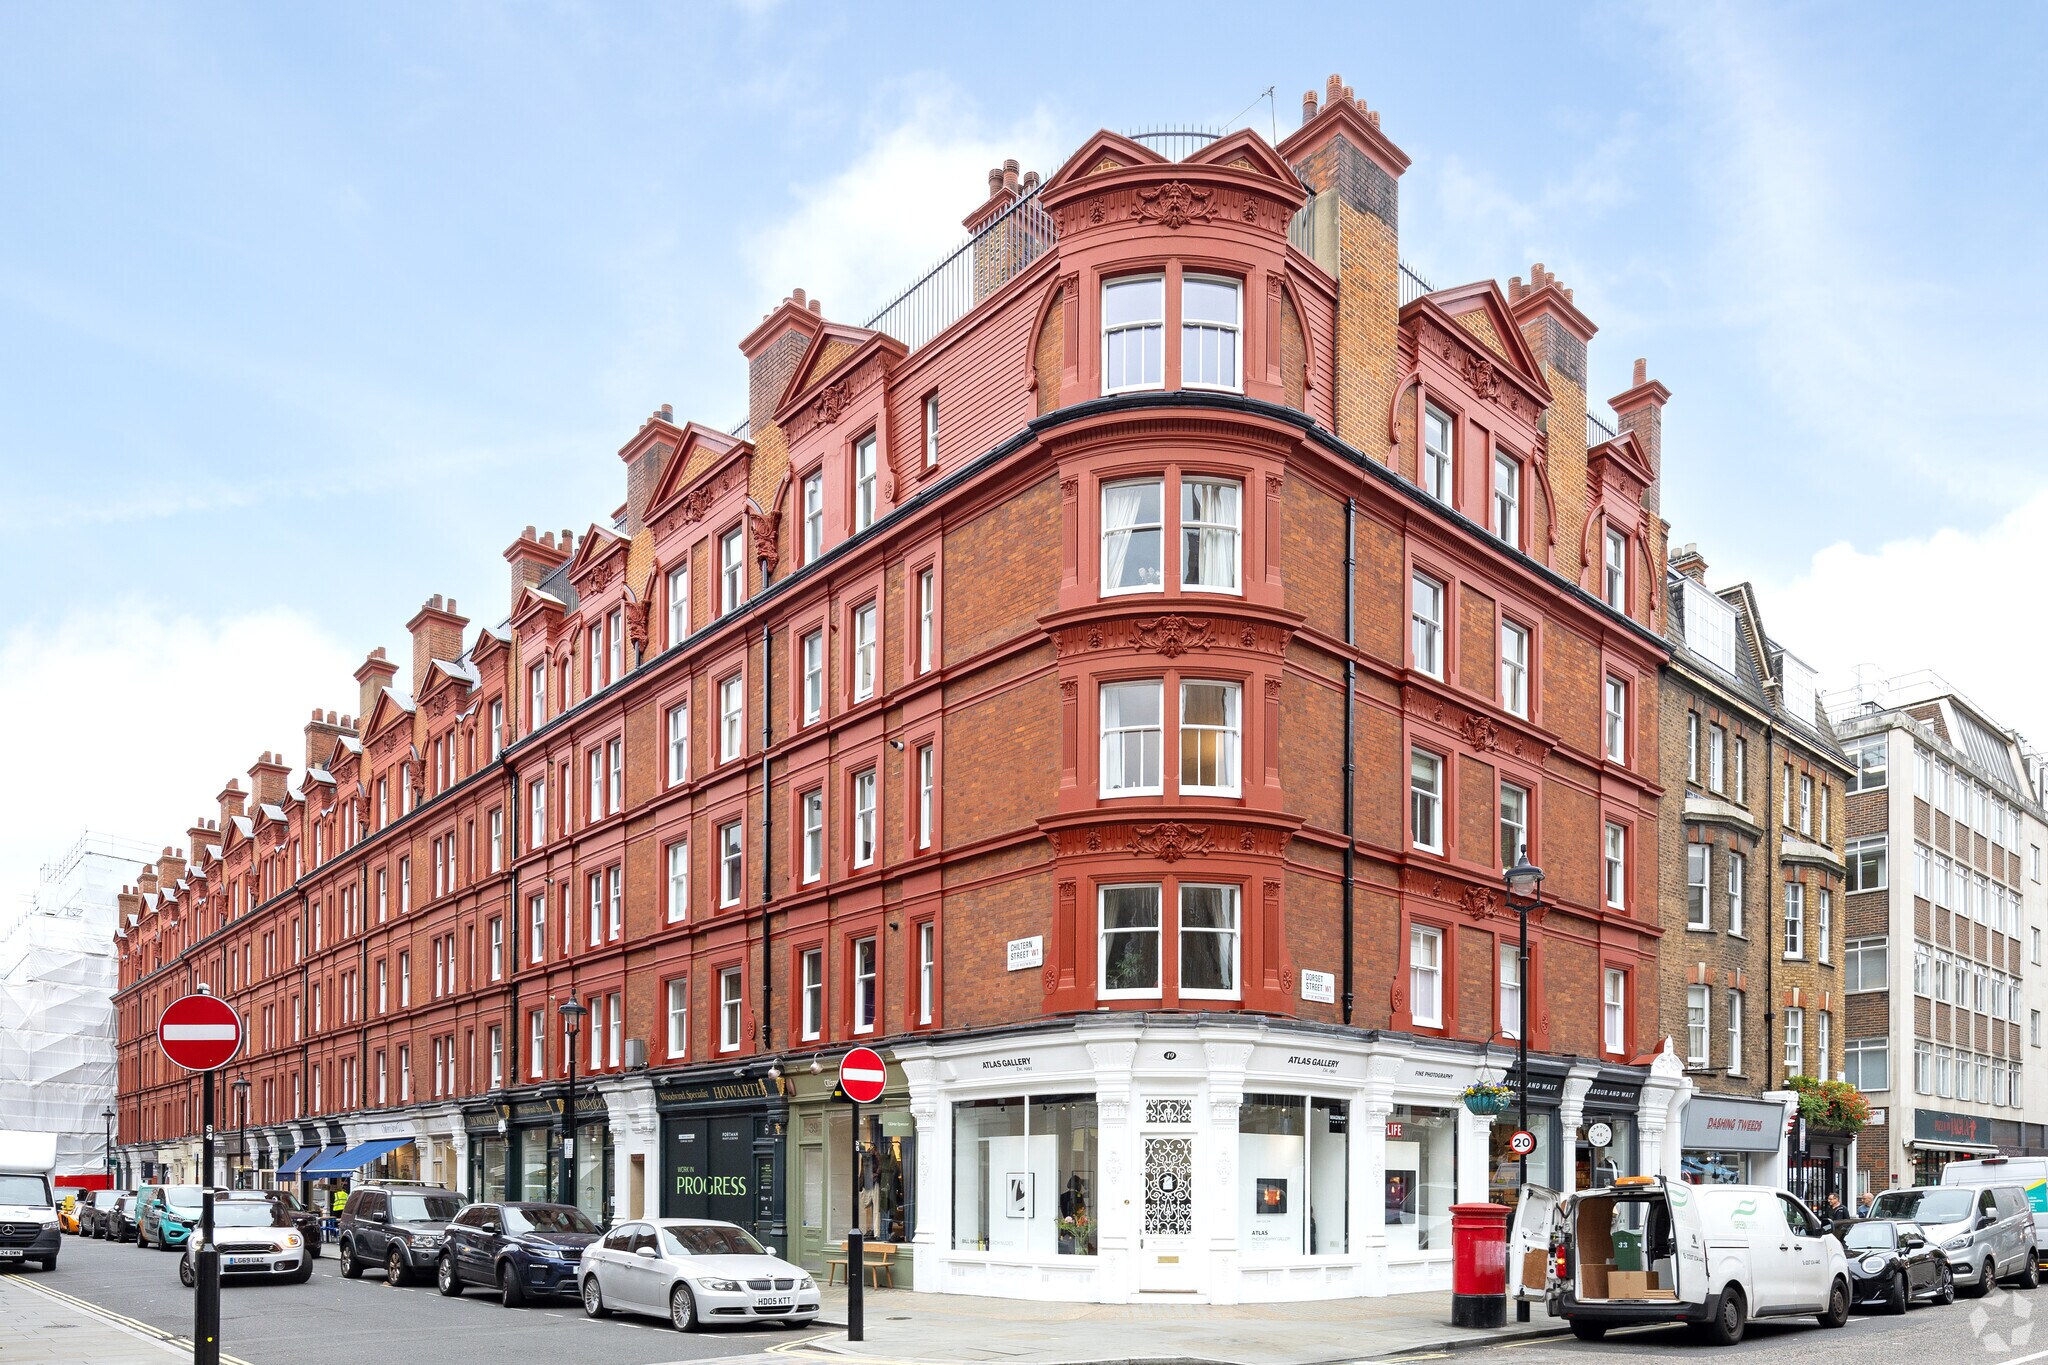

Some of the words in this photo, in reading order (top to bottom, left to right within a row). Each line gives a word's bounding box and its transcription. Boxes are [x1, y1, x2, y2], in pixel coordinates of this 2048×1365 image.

[1011, 941, 1033, 951] CHILTERN
[1011, 950, 1029, 960] STREET
[1031, 949, 1039, 957] W1
[1306, 973, 1323, 982] DORSET
[1306, 982, 1323, 991] STREET
[983, 1060, 1002, 1069] ATLAS
[1002, 1057, 1031, 1067] GALLERY
[1288, 1056, 1311, 1065] ATLAS
[1312, 1058, 1339, 1068] GALLERY
[713, 1083, 766, 1099] HOWARTH
[1541, 1083, 1558, 1091] WAIT
[660, 1092, 686, 1101] Woodwind
[687, 1089, 709, 1100] Specialist
[206, 1124, 213, 1132] S
[1707, 1118, 1736, 1130] DASHING
[1738, 1120, 1763, 1131] TWEEDS
[1387, 1124, 1402, 1136] LIFE
[206, 1132, 213, 1140] 4
[1514, 1138, 1530, 1147] 20
[677, 1176, 747, 1196] PROGRESS
[757, 1297, 777, 1305] HD05
[778, 1296, 791, 1304] KTT
